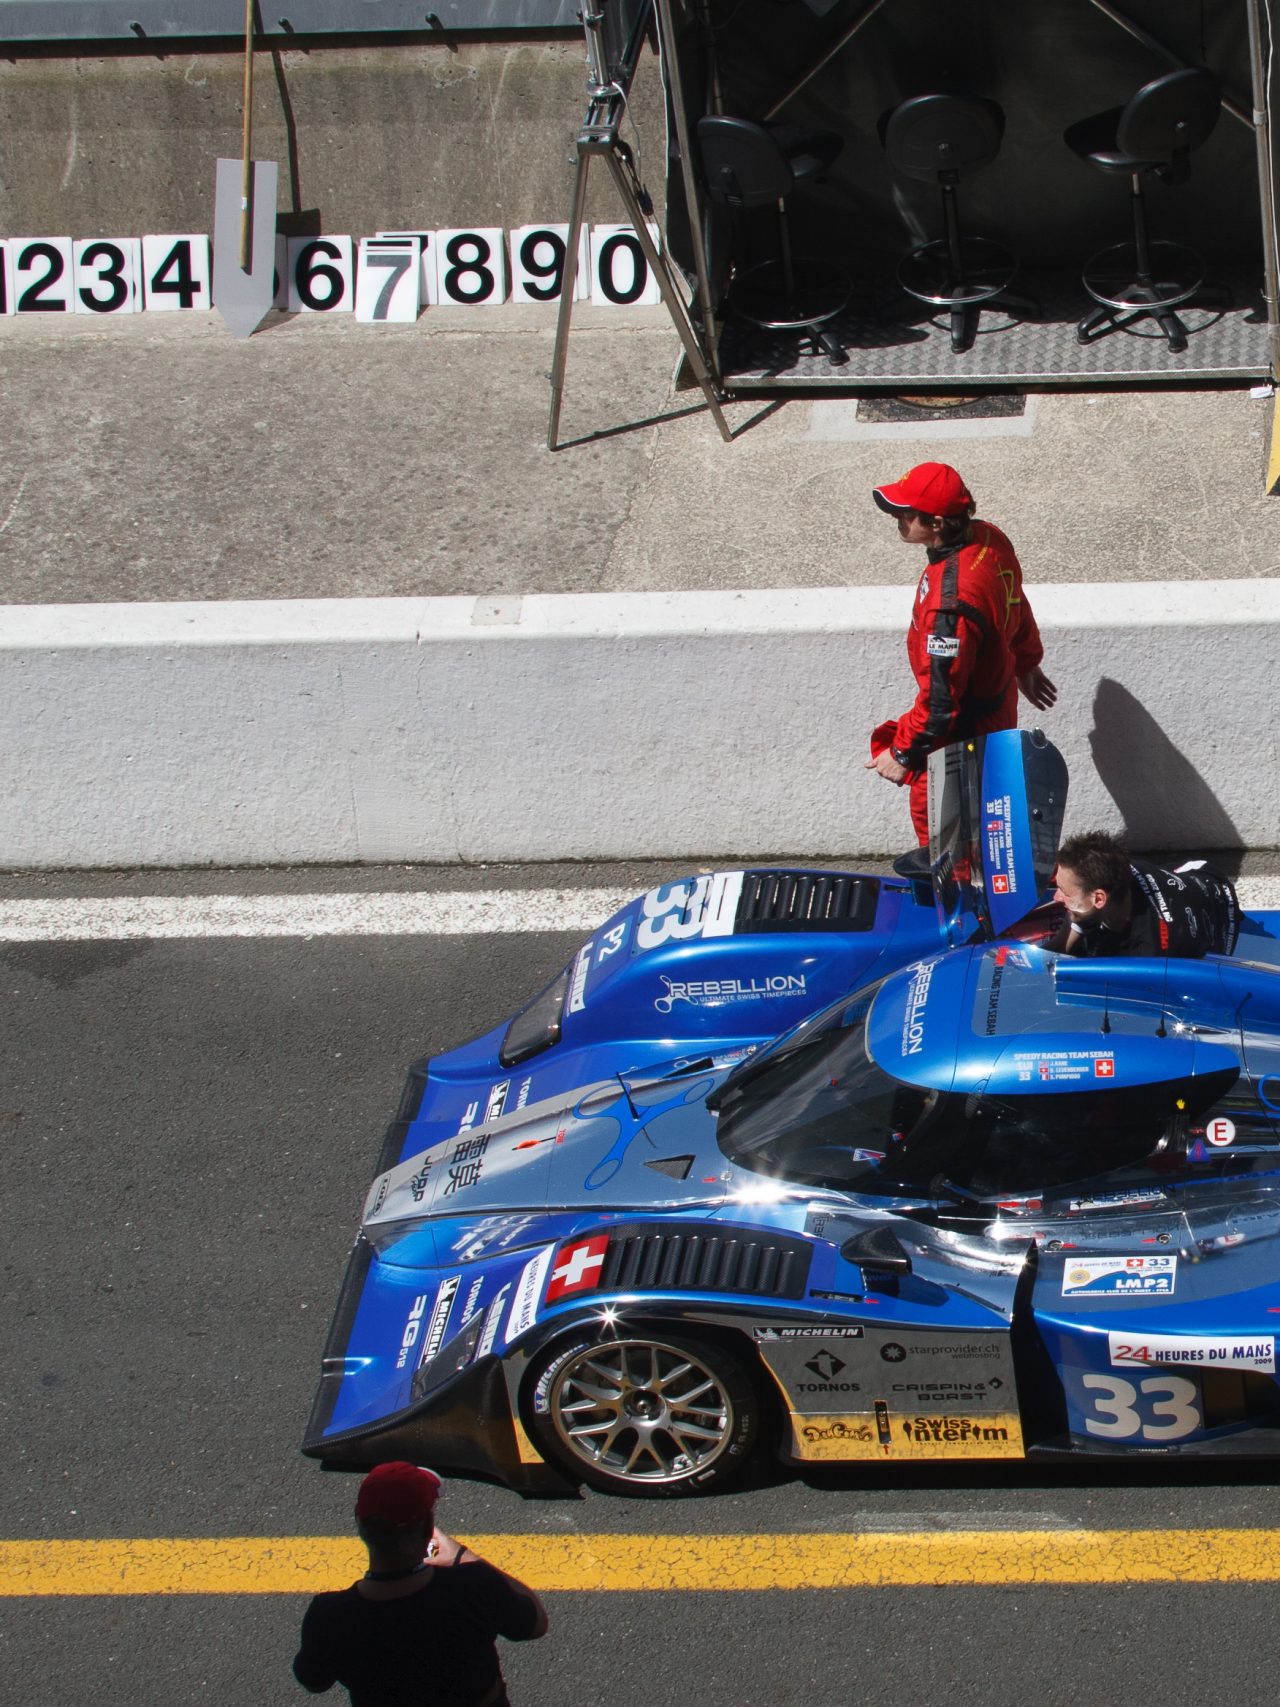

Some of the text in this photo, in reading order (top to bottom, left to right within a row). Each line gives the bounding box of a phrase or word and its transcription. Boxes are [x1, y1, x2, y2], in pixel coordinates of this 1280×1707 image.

[18, 242, 66, 311] 2
[79, 242, 128, 312] 3
[151, 240, 201, 309] 4
[296, 241, 345, 310] 6
[366, 254, 412, 320] 7
[445, 233, 495, 302] 8
[519, 230, 565, 300] 9
[670, 974, 806, 998] REBELLION
[908, 964, 934, 1055] REBELLION
[1214, 1122, 1227, 1141] E
[1149, 1258, 1170, 1267] 33
[461, 1275, 484, 1324] TORNOS
[519, 1303, 532, 1329] MANS
[780, 1328, 859, 1337] MICHELIN
[909, 1344, 1000, 1355] starprovider.ch
[1114, 1344, 1272, 1361] 24 HEURES DU MANS
[797, 1383, 861, 1393] TORNOS
[918, 1393, 987, 1401] BORST
[1083, 1374, 1201, 1440] 33
[914, 1416, 971, 1429] Swiss
